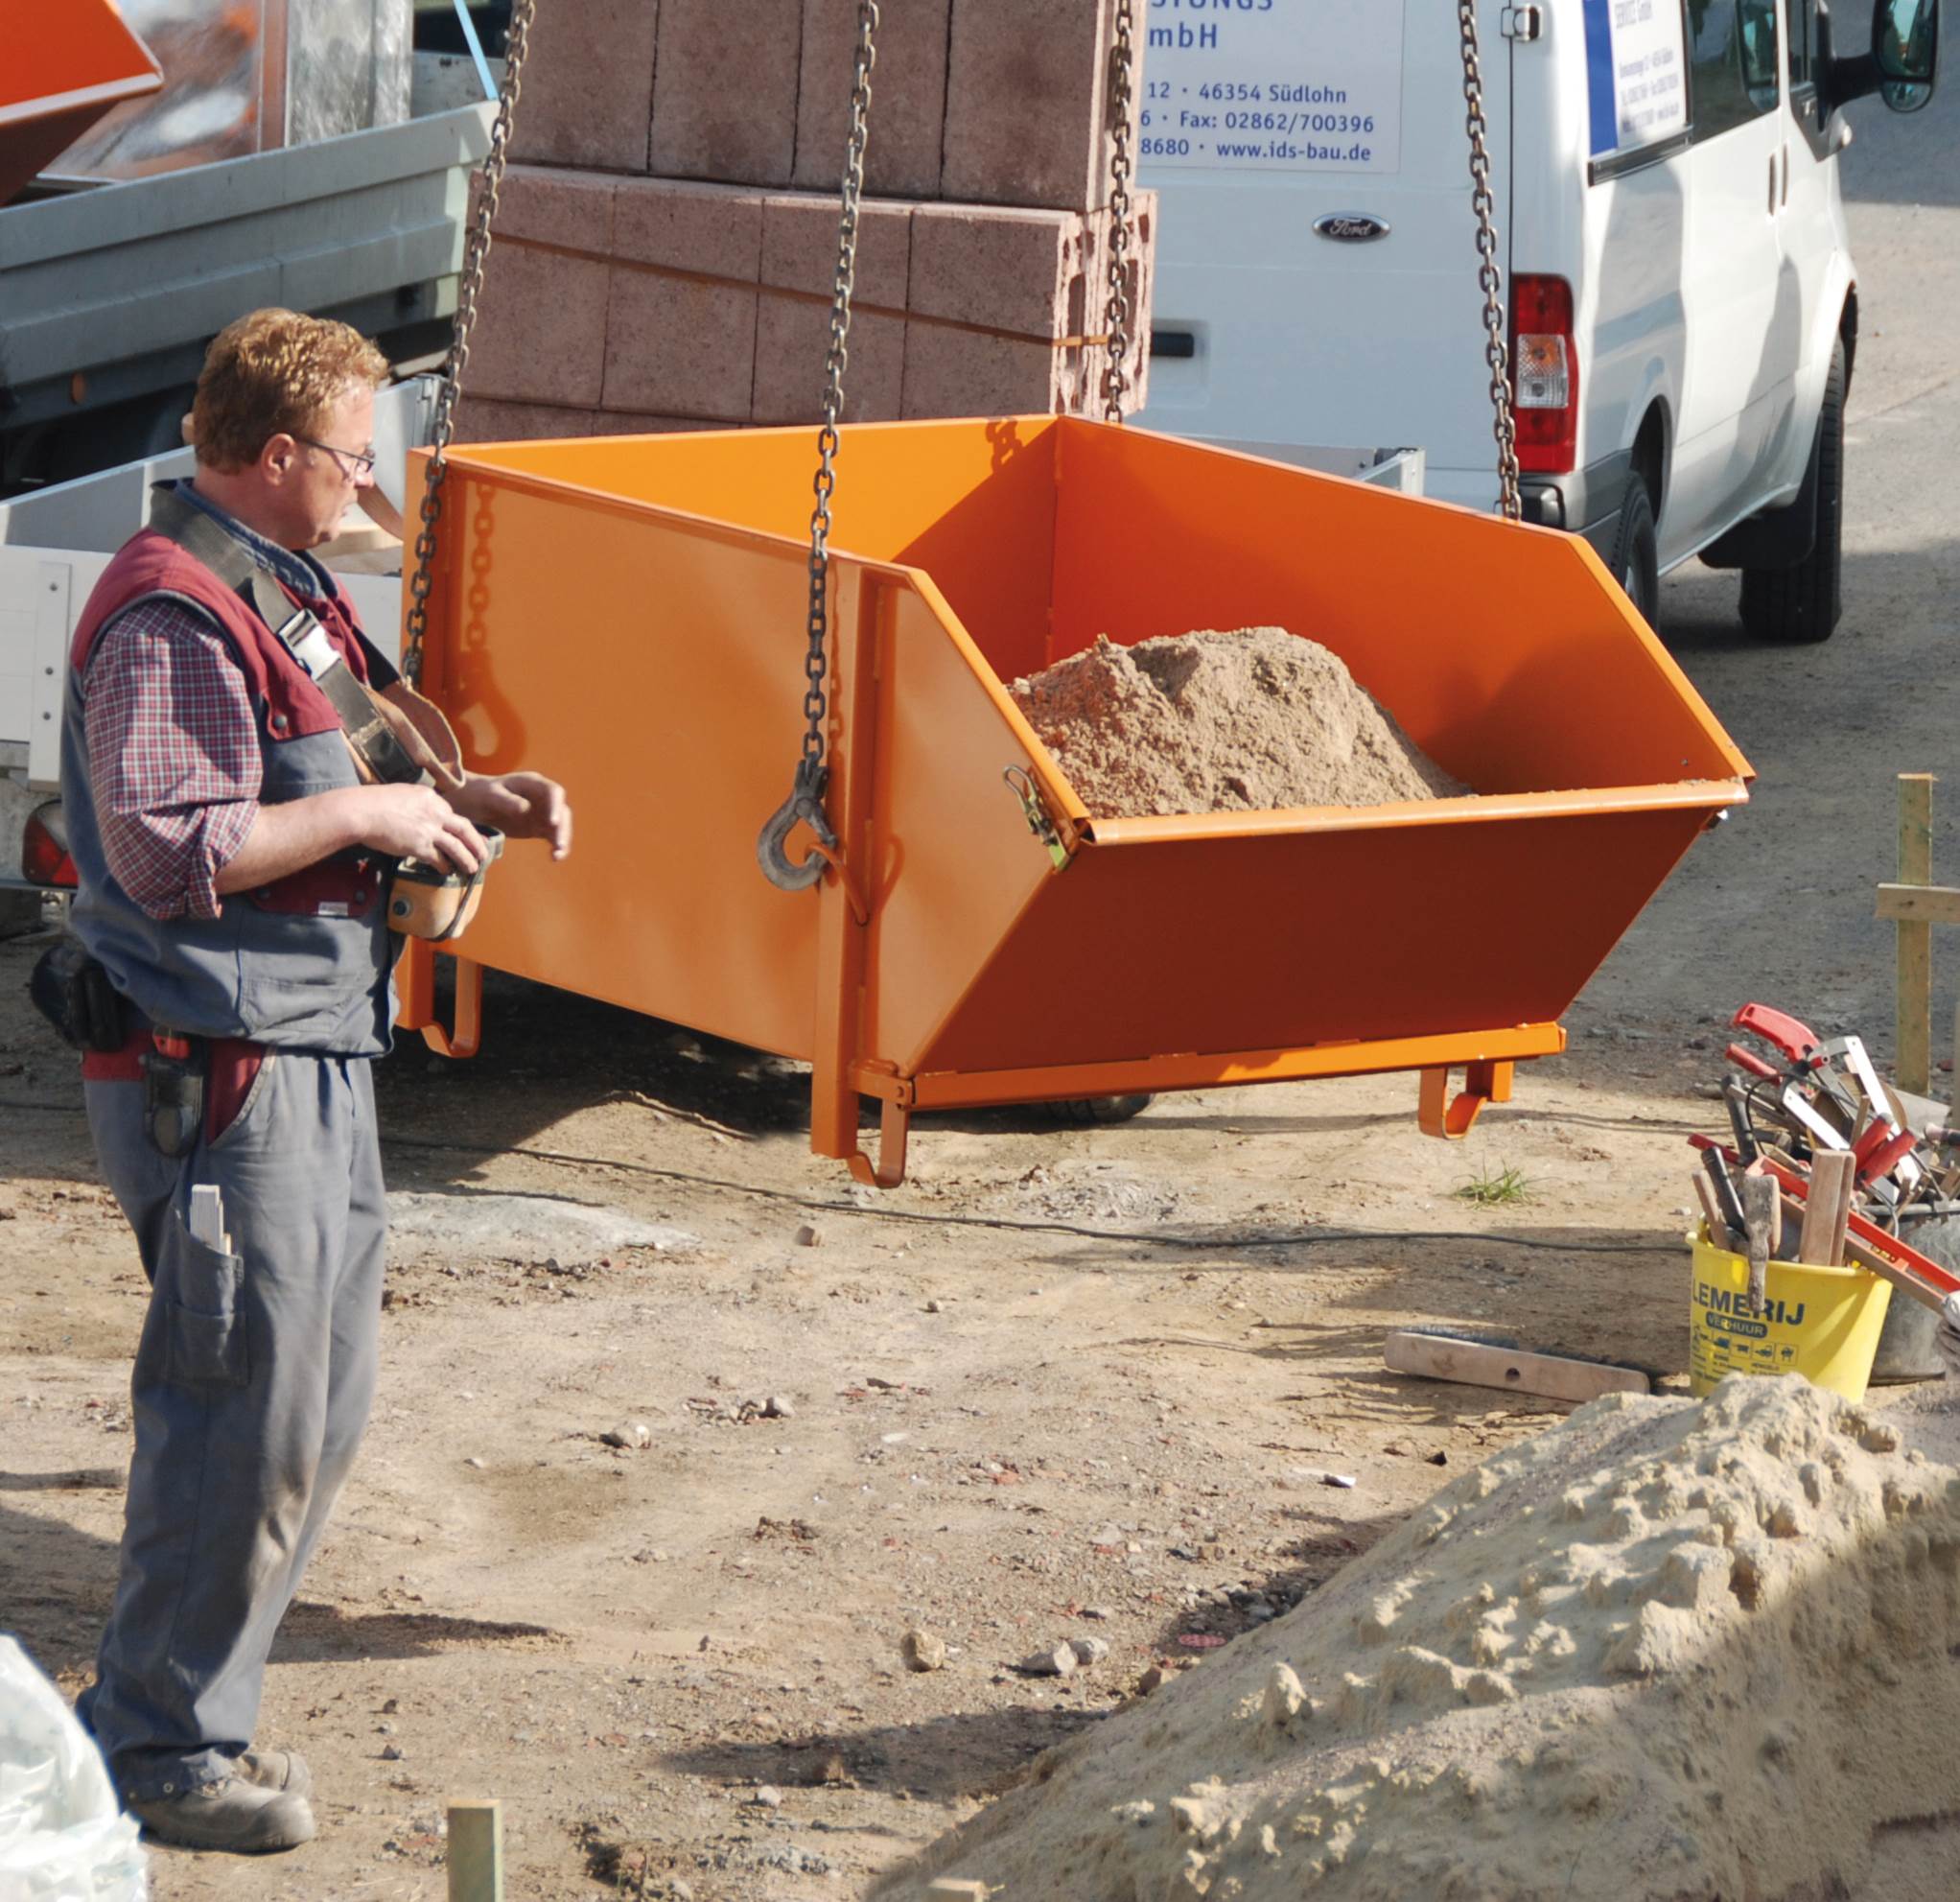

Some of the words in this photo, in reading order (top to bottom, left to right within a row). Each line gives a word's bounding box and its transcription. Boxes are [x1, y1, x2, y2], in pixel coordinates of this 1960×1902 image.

[1148, 21, 1218, 50] mbH
[1148, 82, 1171, 100] 12
[1198, 82, 1262, 103] 46354
[1269, 83, 1348, 105] Südlohn
[1139, 109, 1152, 129] 6
[1179, 110, 1218, 129] Fax:
[1225, 112, 1374, 135] 02862/700396
[1140, 137, 1190, 156] 8680
[1216, 140, 1372, 162] www.ids-bau.de
[1328, 217, 1373, 238] Ford
[1707, 1312, 1765, 1336] VEHUUR
